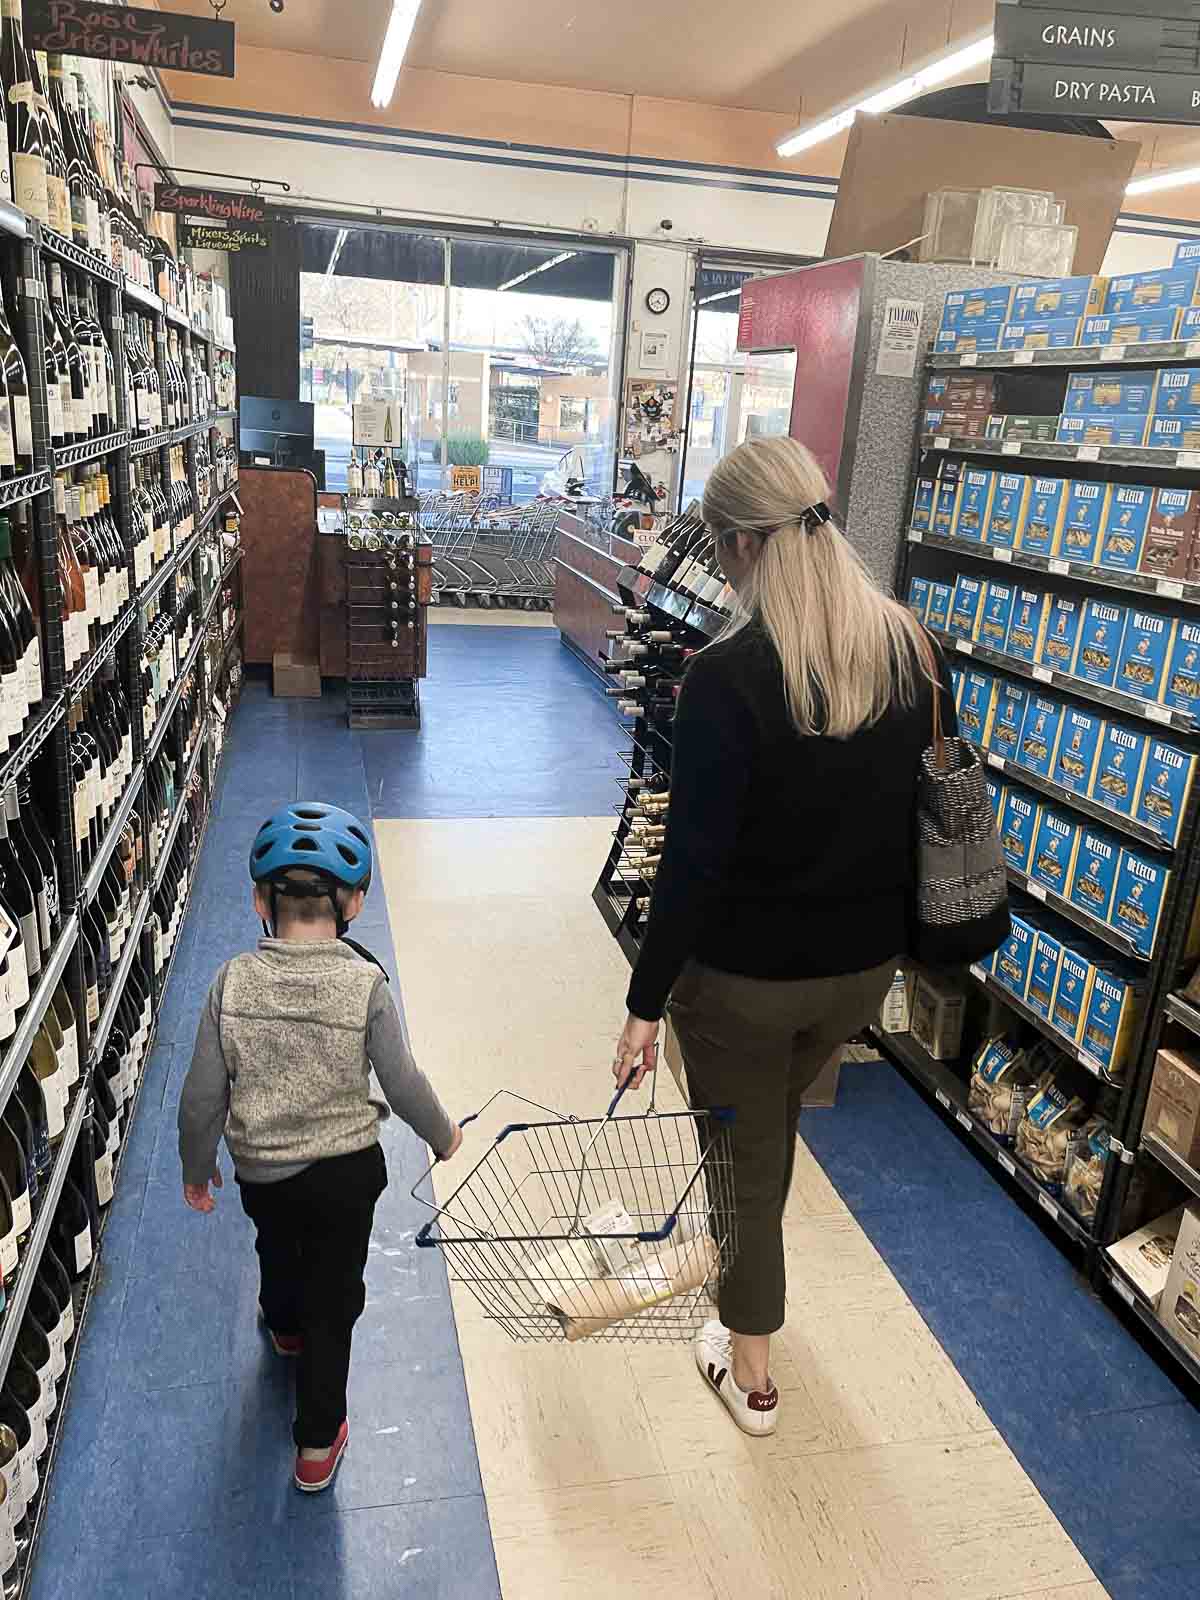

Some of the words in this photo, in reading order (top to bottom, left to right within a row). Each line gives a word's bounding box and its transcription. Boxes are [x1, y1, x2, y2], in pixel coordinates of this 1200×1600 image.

[1041, 24, 1117, 48] GRAINS
[1054, 80, 1096, 100] DRY
[1098, 83, 1157, 105] PASTA
[453, 478, 478, 487] HELP!
[638, 534, 657, 543] CLO
